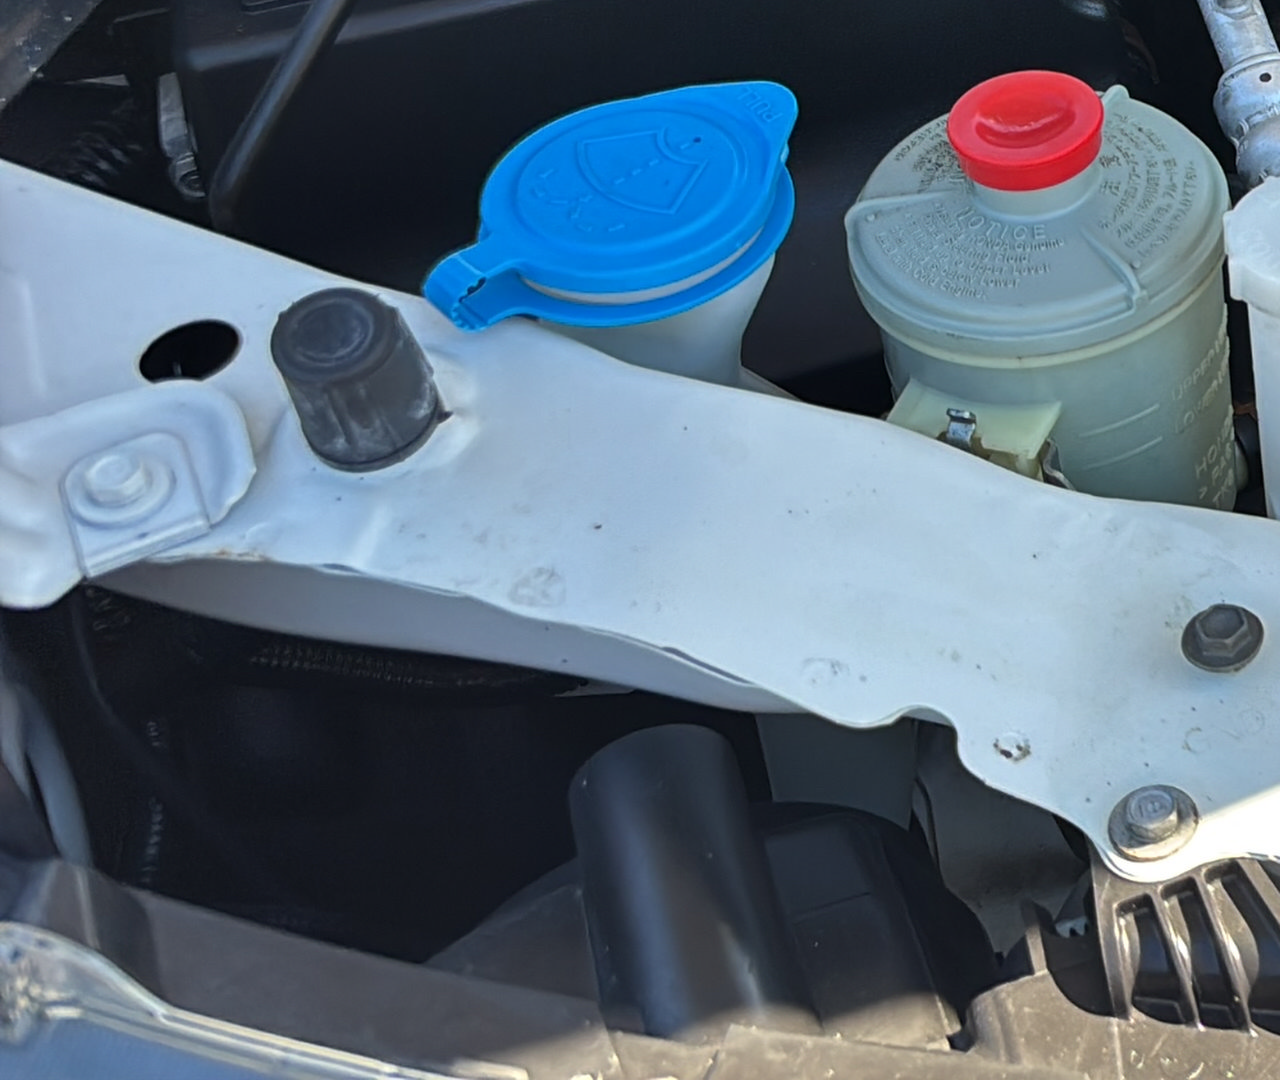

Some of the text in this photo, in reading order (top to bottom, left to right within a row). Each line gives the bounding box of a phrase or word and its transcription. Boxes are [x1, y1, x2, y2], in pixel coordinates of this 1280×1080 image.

[738, 85, 783, 124] PULL
[953, 205, 1048, 241] NOTICE
[967, 234, 1010, 251] HONDA
[913, 267, 940, 287] Cold
[968, 260, 1008, 277] Upper
[1012, 263, 1051, 277] Level
[979, 275, 1022, 289] Lower
